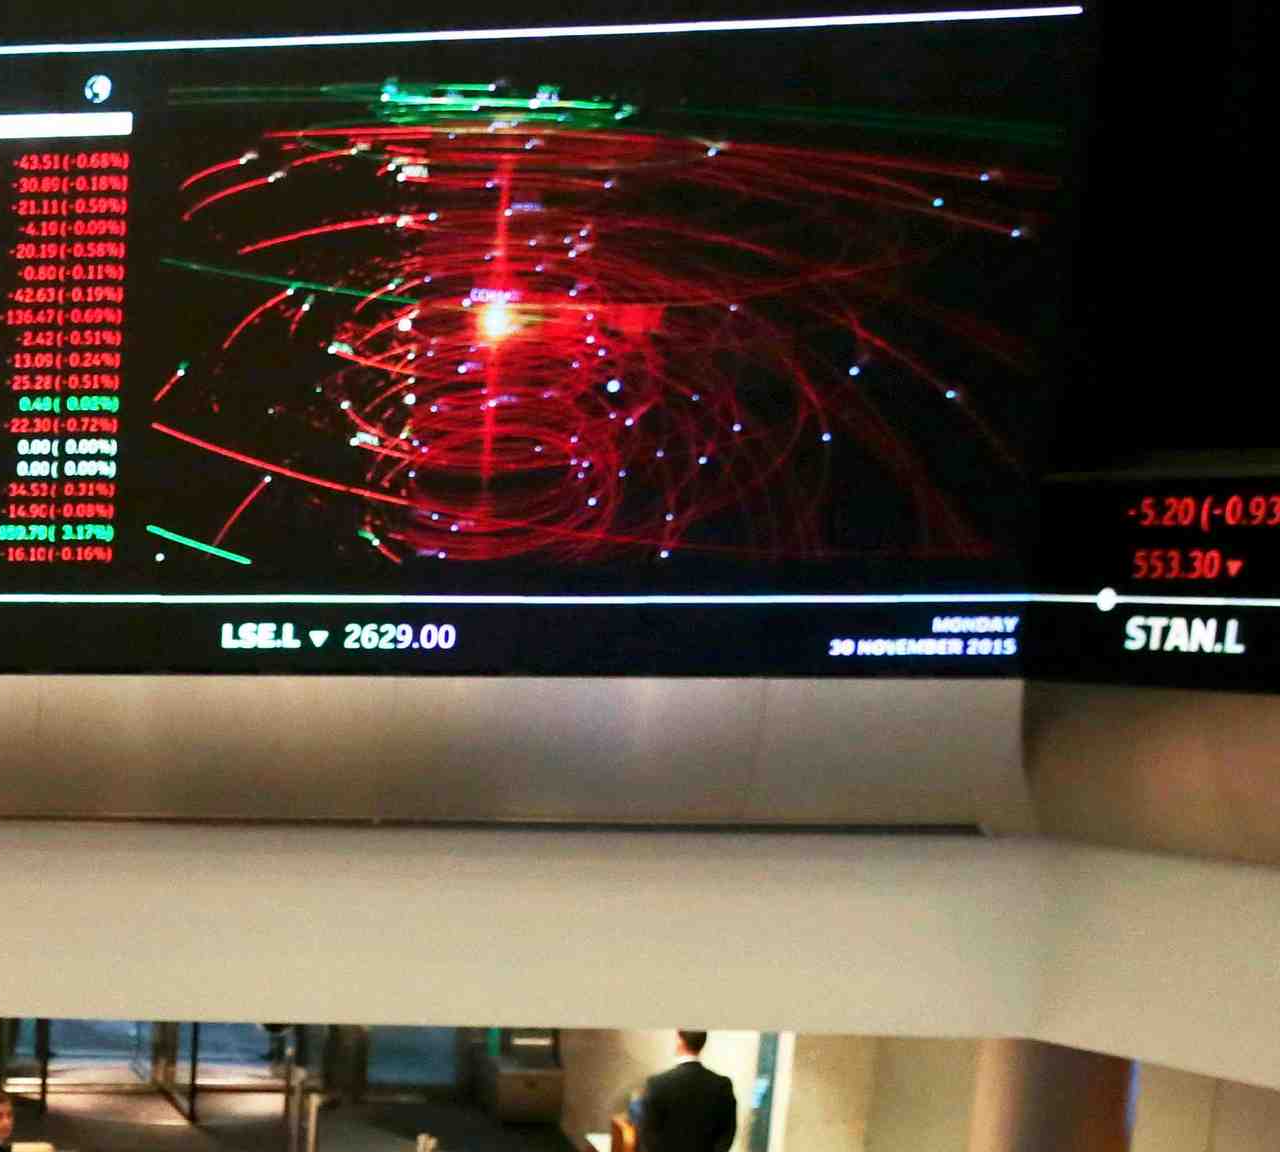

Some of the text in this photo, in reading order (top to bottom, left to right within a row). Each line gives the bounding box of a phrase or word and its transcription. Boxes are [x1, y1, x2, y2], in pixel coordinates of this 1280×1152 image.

[19, 397, 53, 411] 0.4
[1133, 549, 1221, 578] 553.30
[221, 623, 301, 648] LSE.L
[344, 623, 456, 649] 2629.00
[932, 616, 1019, 633] MONDAY
[1125, 616, 1245, 653] STAN.L
[829, 638, 1017, 656] 30 NOVEMBER 2015
